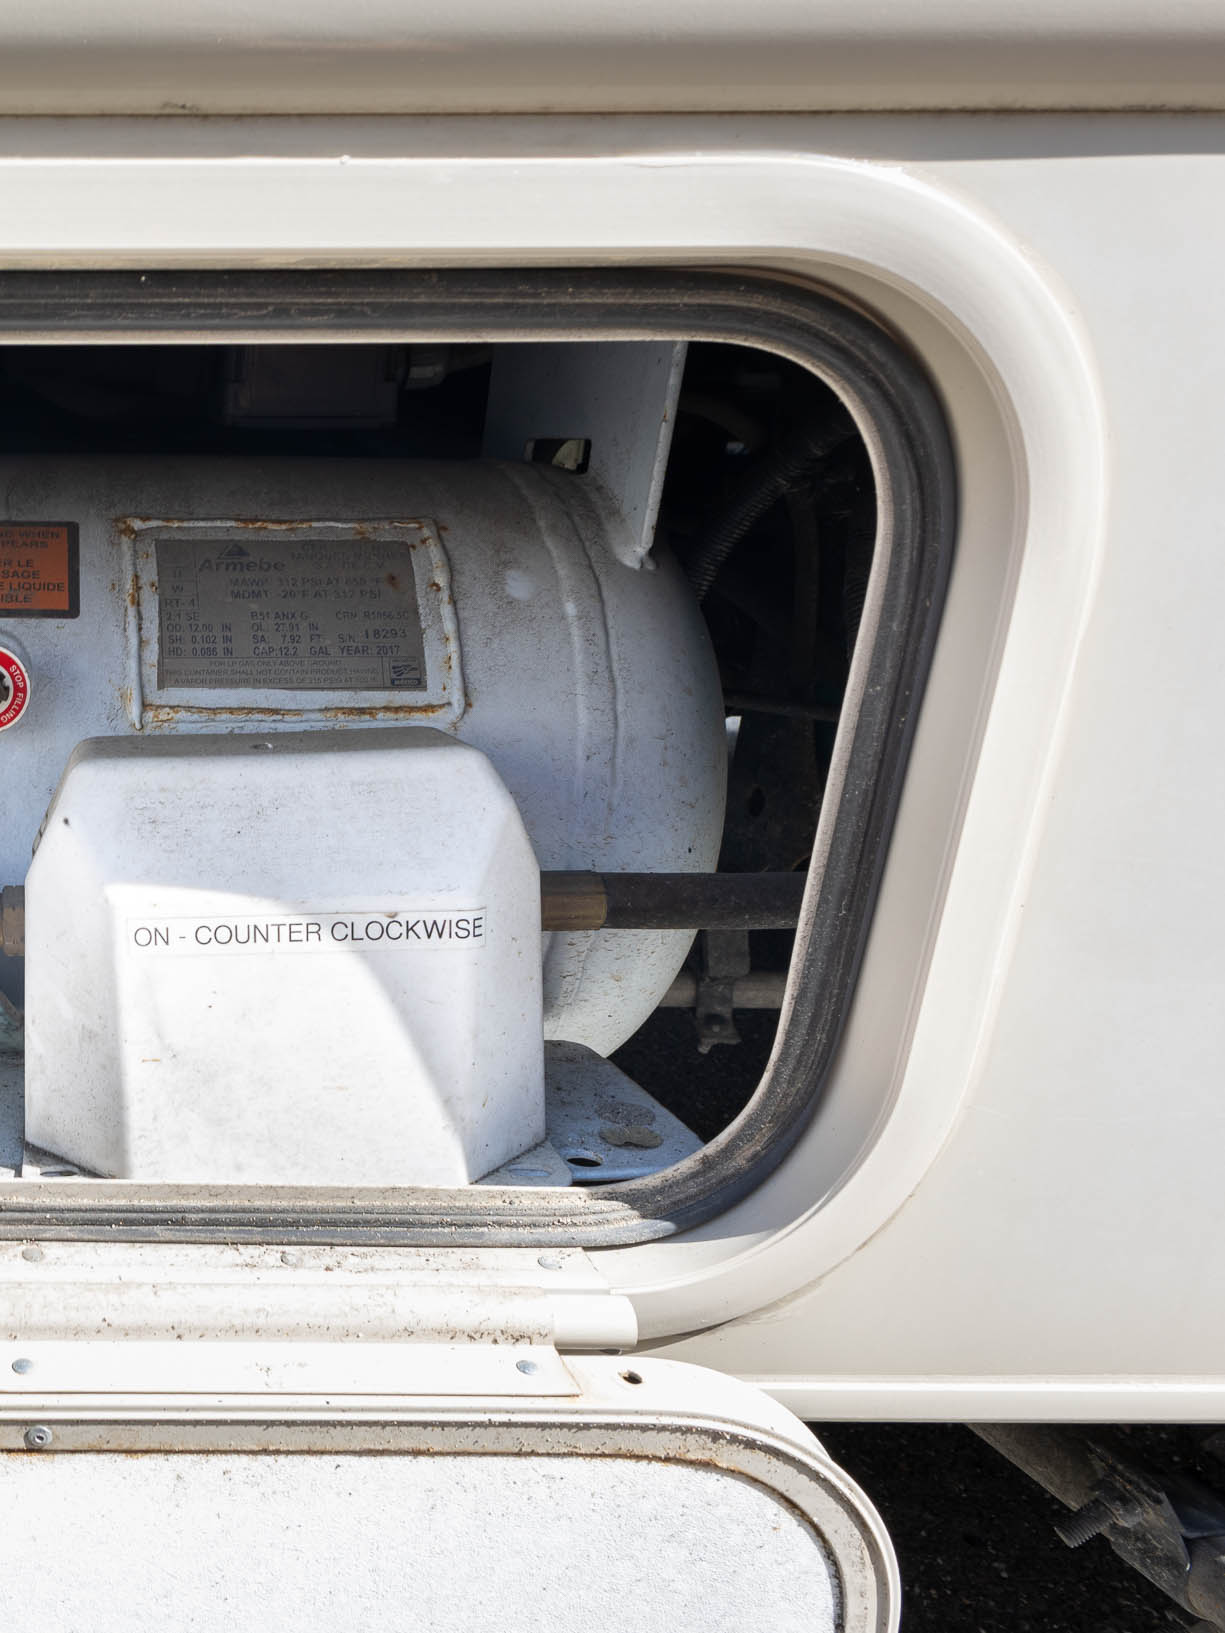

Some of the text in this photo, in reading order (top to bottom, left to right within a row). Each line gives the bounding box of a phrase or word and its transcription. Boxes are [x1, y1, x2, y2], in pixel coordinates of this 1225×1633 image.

[18, 559, 34, 568] LE
[199, 557, 287, 572] Armebe
[9, 582, 65, 592] LIQUIDE
[222, 623, 232, 632] IN
[308, 623, 320, 632] IN
[223, 635, 232, 644] IN
[223, 647, 233, 656] IN
[310, 646, 331, 656] GAL
[376, 645, 400, 656] 2017
[9, 664, 24, 688] STOP
[0, 692, 24, 722] FILLING
[134, 927, 170, 947] ON
[194, 922, 322, 945] COUNTER
[330, 917, 484, 942] CLOCKWISE
